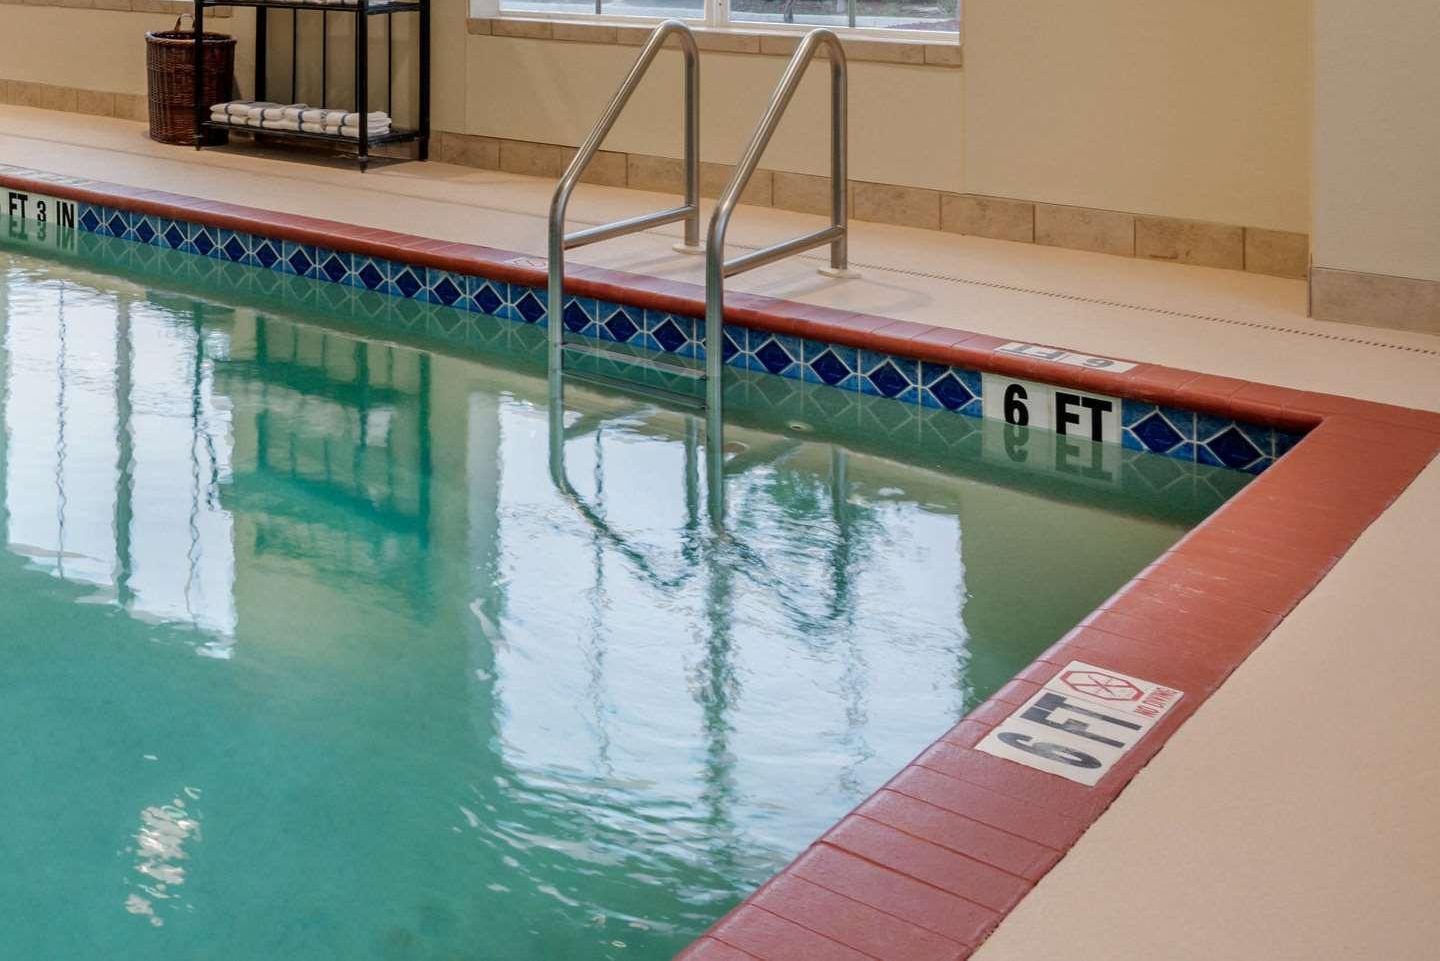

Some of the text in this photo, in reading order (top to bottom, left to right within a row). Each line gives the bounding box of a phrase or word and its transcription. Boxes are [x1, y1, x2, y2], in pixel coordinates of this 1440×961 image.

[8, 192, 28, 218] FT
[37, 200, 47, 223] 3
[56, 201, 75, 229] IN
[996, 344, 1115, 368] 6 FT
[1003, 384, 1112, 443] 6 FT
[997, 692, 1143, 769] 6 FT
